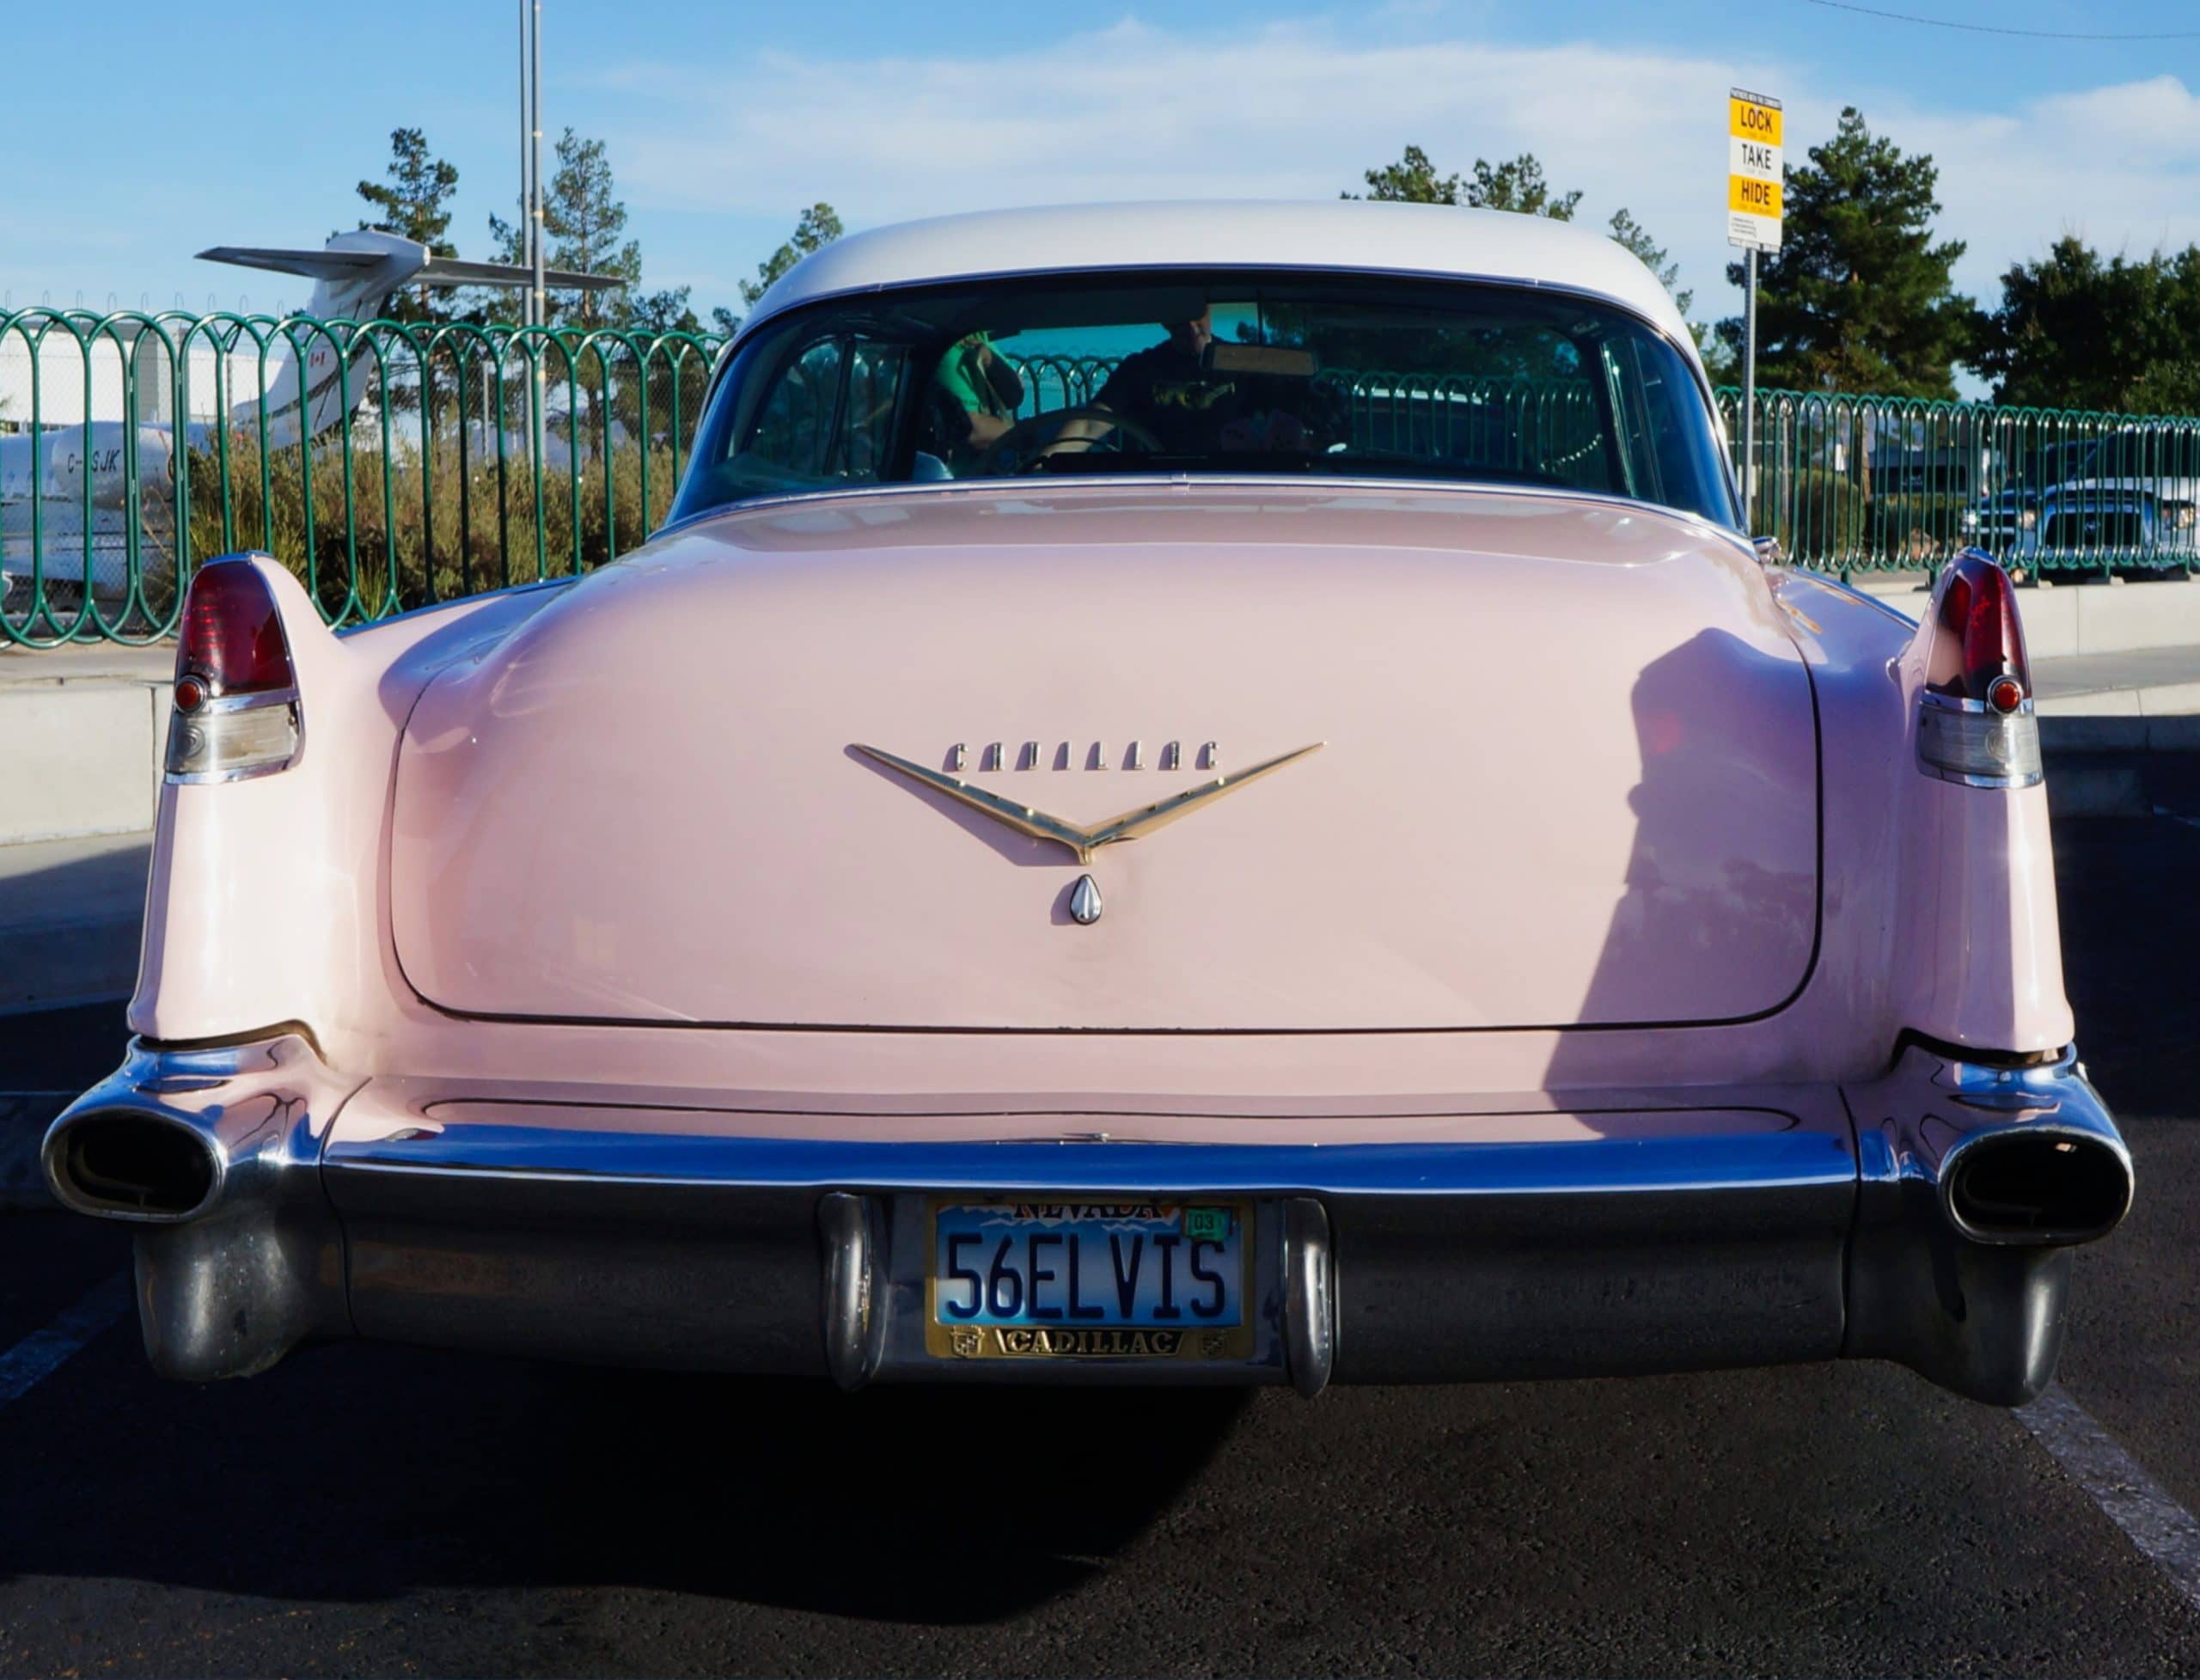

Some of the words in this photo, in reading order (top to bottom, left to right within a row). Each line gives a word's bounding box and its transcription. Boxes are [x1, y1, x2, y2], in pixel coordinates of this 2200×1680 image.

[1740, 104, 1773, 134] LOCK
[1742, 144, 1772, 170] TAKE
[1741, 178, 1770, 205] HIDE
[68, 449, 120, 474] C-SJK
[954, 741, 1218, 771] CADILLAC
[947, 1231, 1226, 1320] 56ELVIS
[1005, 1330, 1175, 1355] CADILLAC
